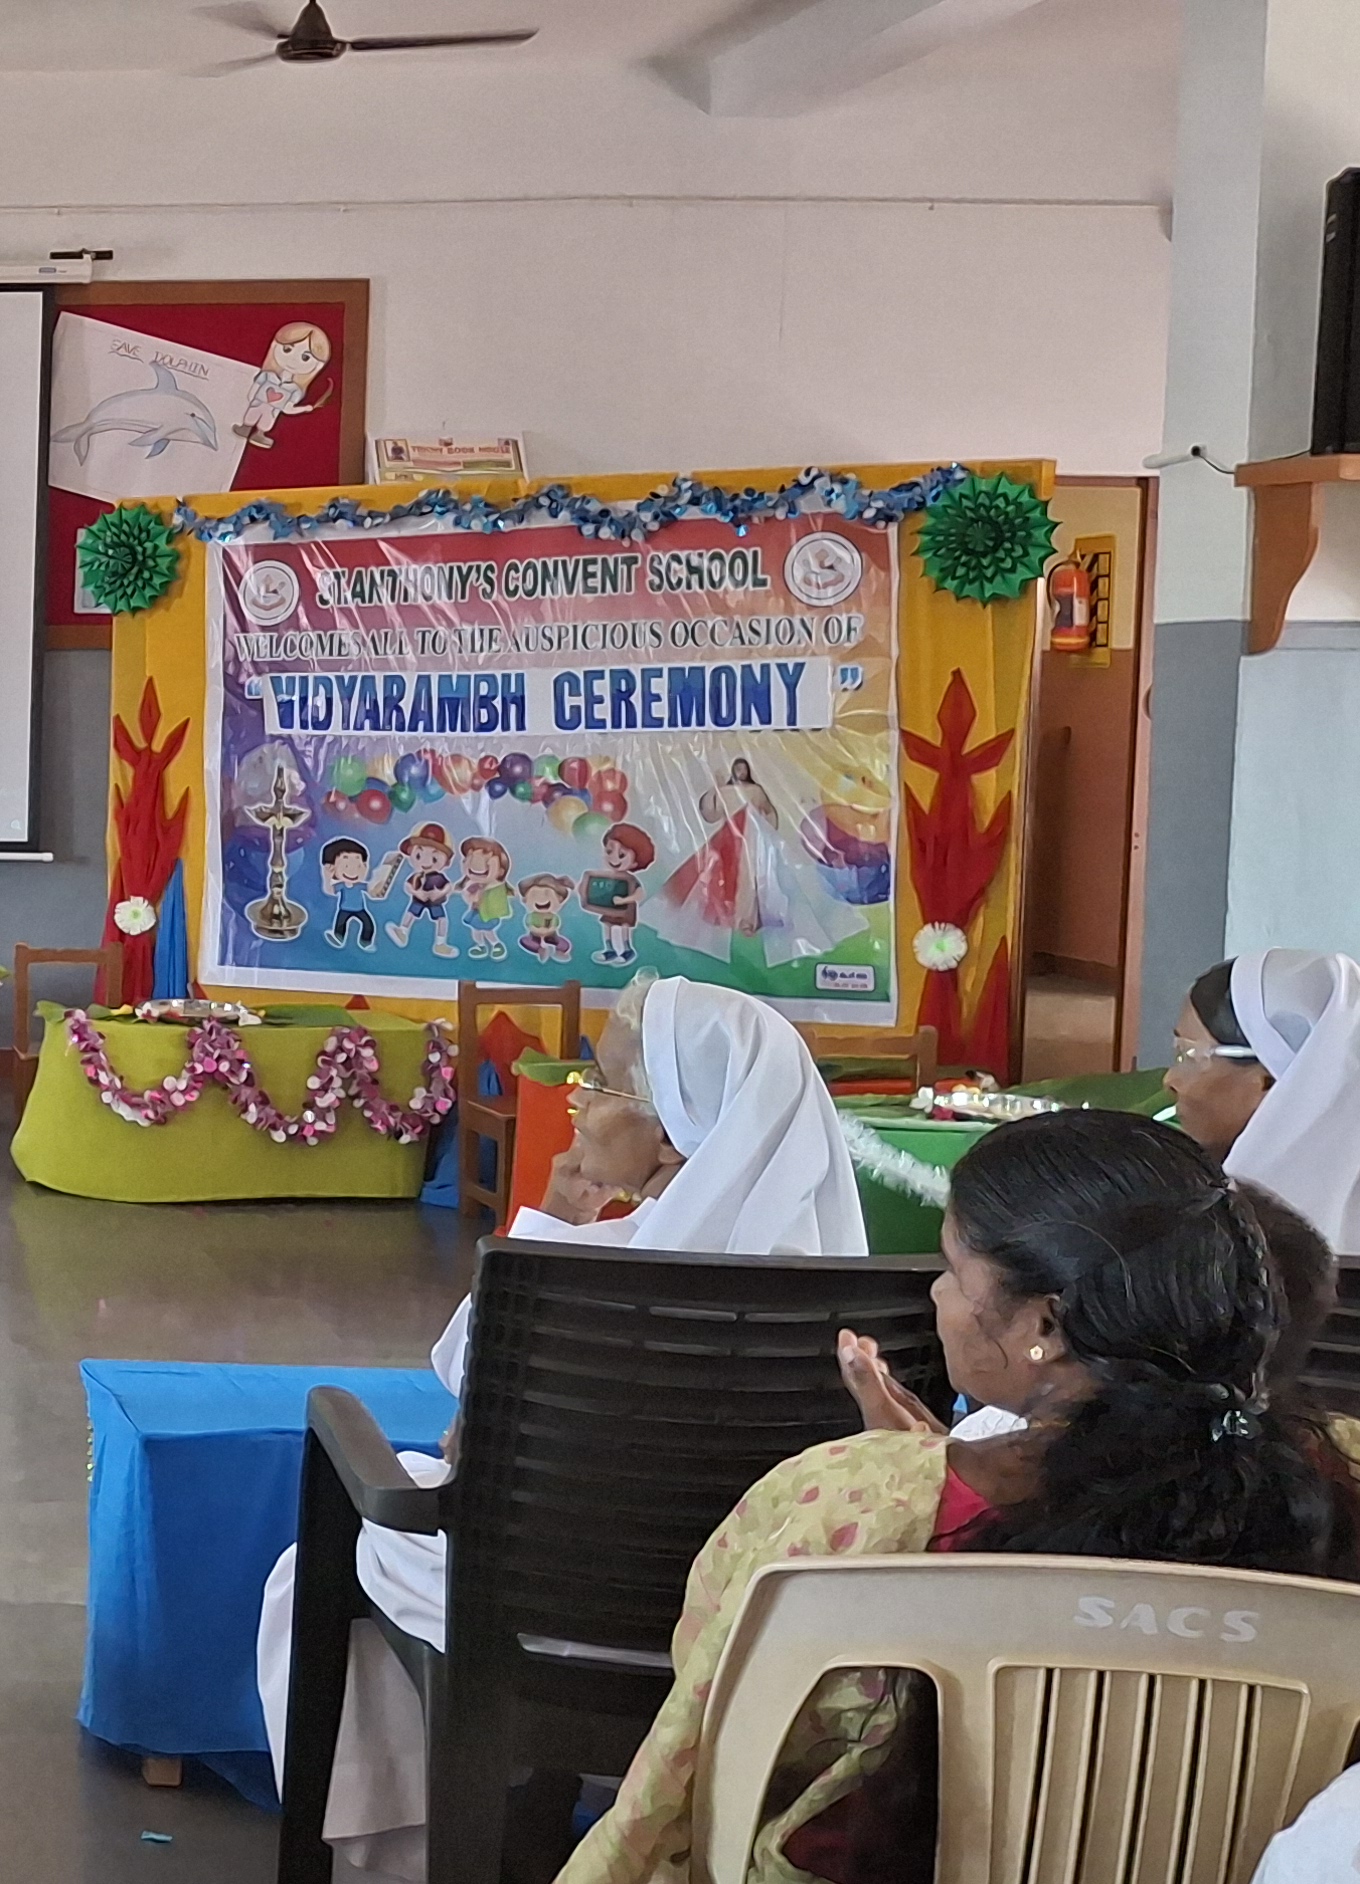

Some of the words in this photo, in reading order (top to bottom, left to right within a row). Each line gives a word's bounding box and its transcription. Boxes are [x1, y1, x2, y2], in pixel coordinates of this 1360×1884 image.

[505, 555, 639, 598] CONVENT
[649, 549, 768, 592] SCHOOL
[367, 628, 409, 657] ALL
[417, 628, 448, 655] TO
[454, 626, 502, 654] THE
[509, 621, 662, 654] AUSPICIOUS
[670, 616, 815, 648] OCCASION
[824, 615, 862, 644] OF
[270, 672, 526, 733] VIDYARAMBH
[553, 662, 806, 730] CEREMONY
[1074, 1596, 1260, 1643] SACS
